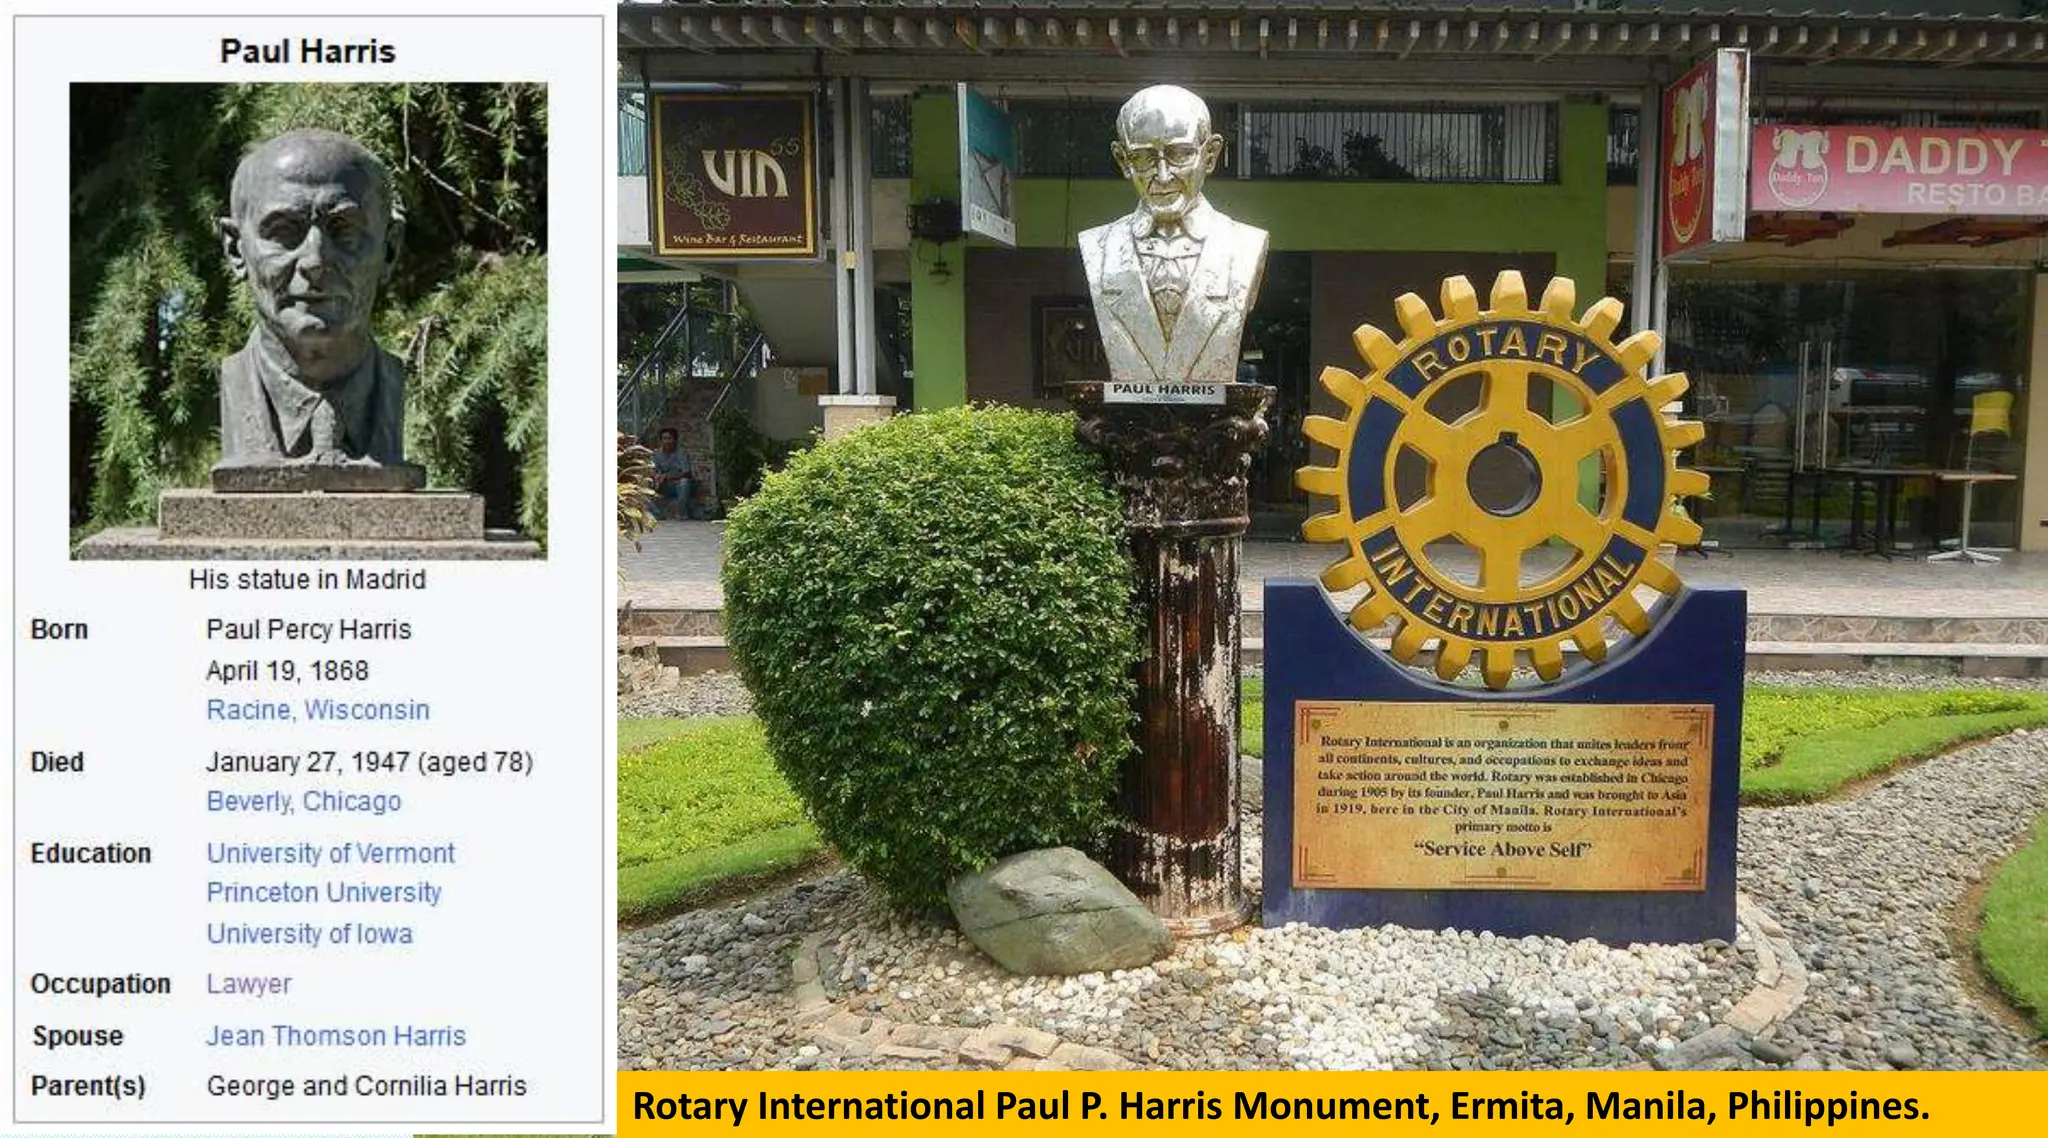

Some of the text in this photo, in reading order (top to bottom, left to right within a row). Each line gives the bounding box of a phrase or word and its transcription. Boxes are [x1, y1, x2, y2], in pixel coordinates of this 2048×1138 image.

[1846, 135, 2024, 176] DADDY
[1908, 182, 2005, 206] RESTO
[674, 234, 704, 244] Wine
[704, 232, 727, 244] Bar
[739, 234, 804, 246] Restaurant
[1411, 325, 1601, 381] ROTARY
[1113, 384, 1216, 396] PAUL HARRIS
[1371, 543, 1635, 638] INTERNATIONAL
[1321, 737, 1362, 750] Rotary
[1365, 737, 1442, 748] International
[1445, 737, 1455, 748] is
[1457, 740, 1472, 748] an
[1474, 738, 1547, 751] organization
[1550, 738, 1574, 749] that
[1318, 754, 1334, 764] all
[1337, 754, 1401, 766] continents,
[1459, 755, 1482, 765] and
[1485, 755, 1556, 768] occupations
[1559, 755, 1571, 766] to
[1574, 755, 1629, 768] exchange
[1632, 756, 1662, 766] ideas
[1666, 756, 1688, 767] and
[1318, 770, 1343, 781] take
[1346, 771, 1382, 781] action
[1384, 771, 1426, 782] around
[1430, 771, 1448, 782] the
[1451, 771, 1488, 782] world.
[1491, 771, 1531, 785] Rotary
[1560, 772, 1624, 783] established
[1626, 772, 1638, 783] in
[1641, 772, 1688, 785] Chicago
[1318, 787, 1358, 800] during
[1362, 787, 1388, 798] 1905
[1391, 787, 1404, 800] by
[1408, 787, 1422, 798] its
[1477, 788, 1503, 799] Paul
[1506, 788, 1545, 799] Harris
[1548, 788, 1569, 799] and
[1573, 791, 1594, 799] was
[1598, 788, 1643, 802] brought
[1647, 789, 1659, 799] to
[1662, 789, 1687, 800] Asia
[1316, 804, 1329, 815] in
[1370, 804, 1399, 815] here
[1402, 804, 1415, 815] in
[1419, 804, 1440, 815] the
[1443, 805, 1470, 818] City
[1473, 805, 1488, 815] of
[1490, 805, 1539, 816] Manila.
[1544, 805, 1588, 818] Rotary
[1455, 821, 1552, 835] primary motto is
[1490, 841, 1546, 857] Above
